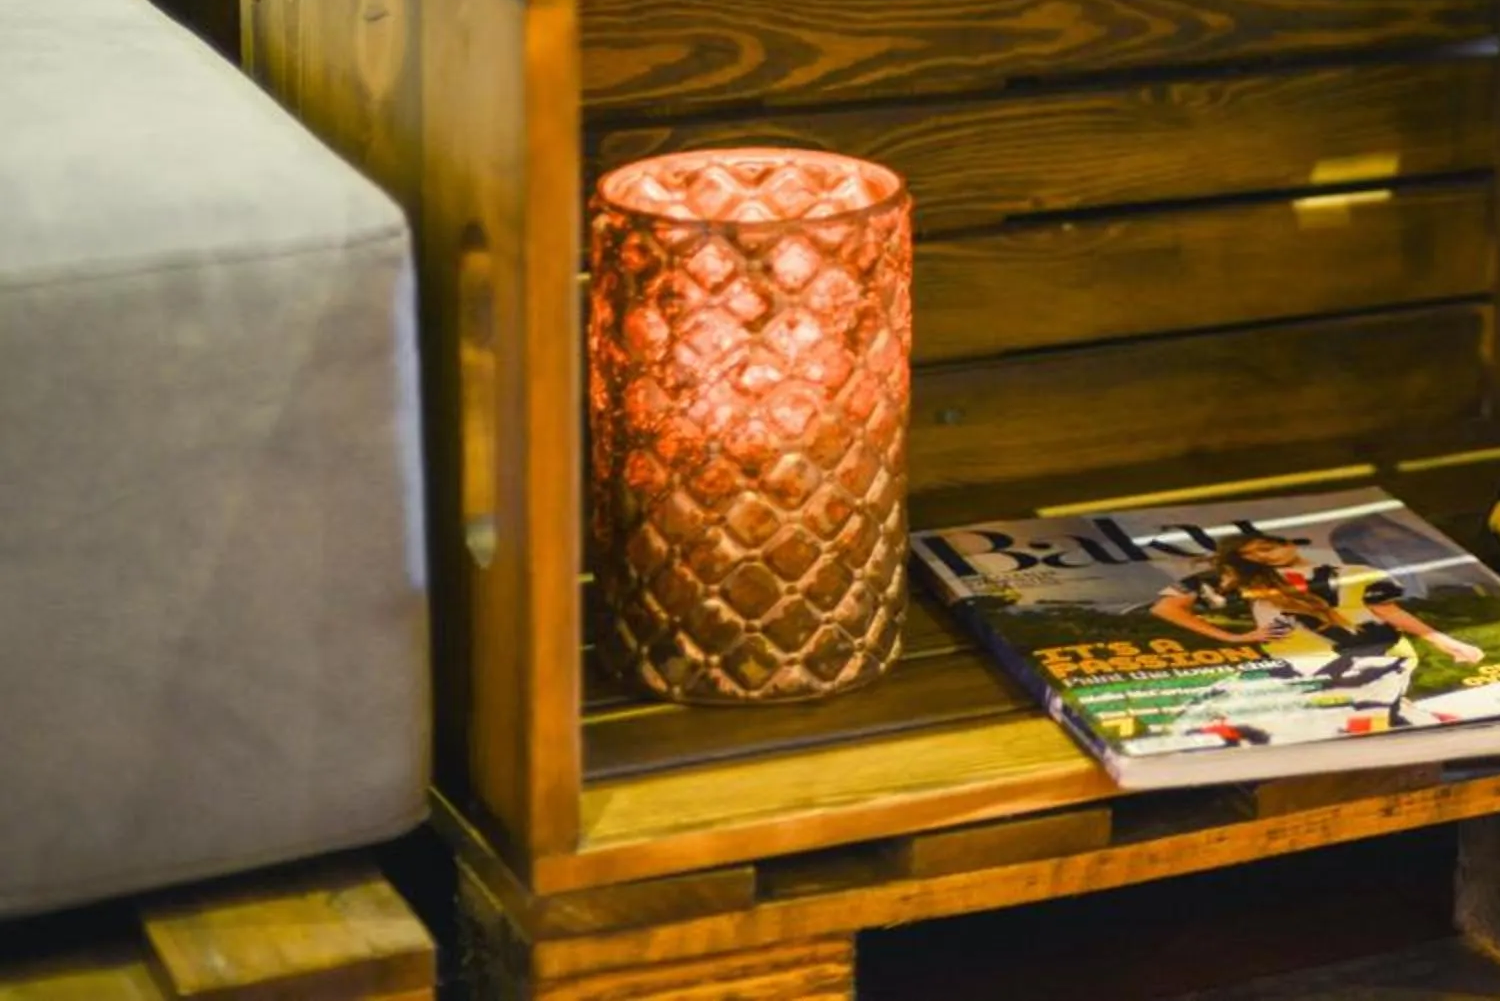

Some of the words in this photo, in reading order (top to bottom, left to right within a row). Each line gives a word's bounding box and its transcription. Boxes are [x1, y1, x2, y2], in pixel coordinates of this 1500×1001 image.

[1034, 641, 1140, 663] IT'S
[1149, 639, 1184, 653] A
[1046, 646, 1261, 680] PASSION
[1063, 671, 1123, 688] Paint
[1129, 667, 1172, 680] the
[1176, 663, 1236, 677] town
